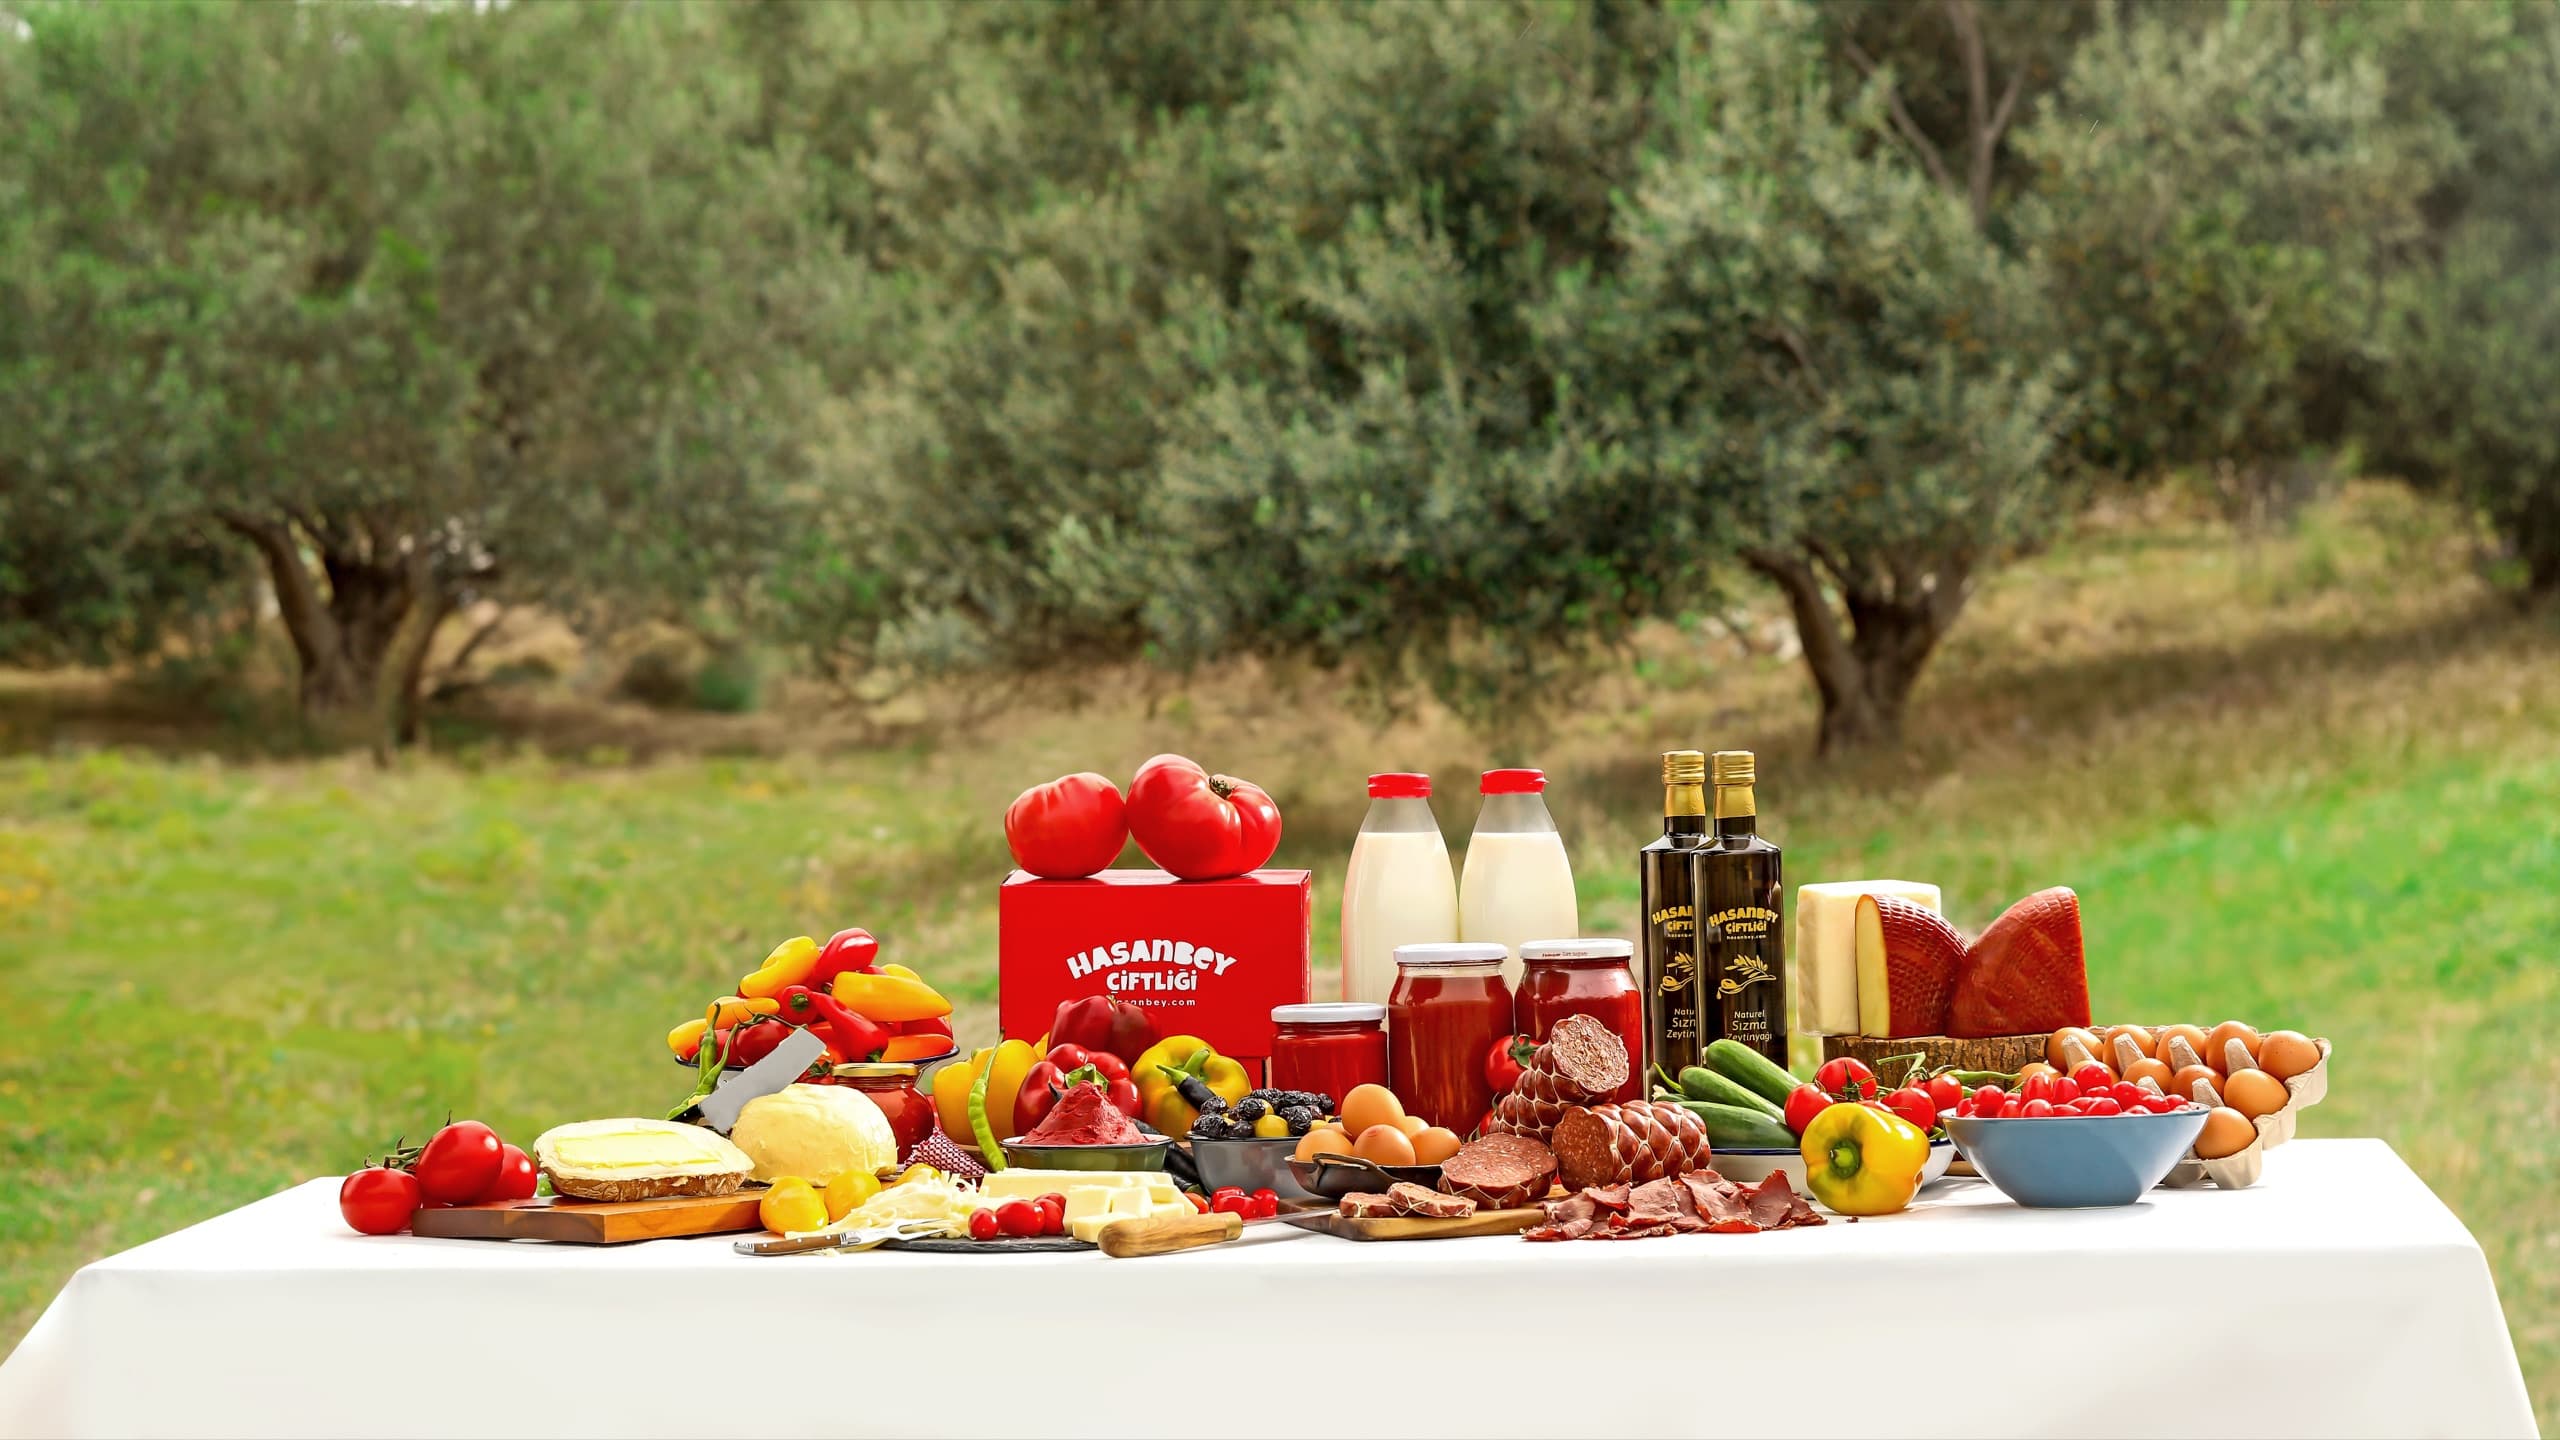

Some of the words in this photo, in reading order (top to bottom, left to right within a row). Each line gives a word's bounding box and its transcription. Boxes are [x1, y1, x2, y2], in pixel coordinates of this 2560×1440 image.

[1116, 998, 1196, 1008] aanbey.com
[1734, 1009, 1765, 1019] Naturel
[1732, 1020, 1767, 1031] Sızma
